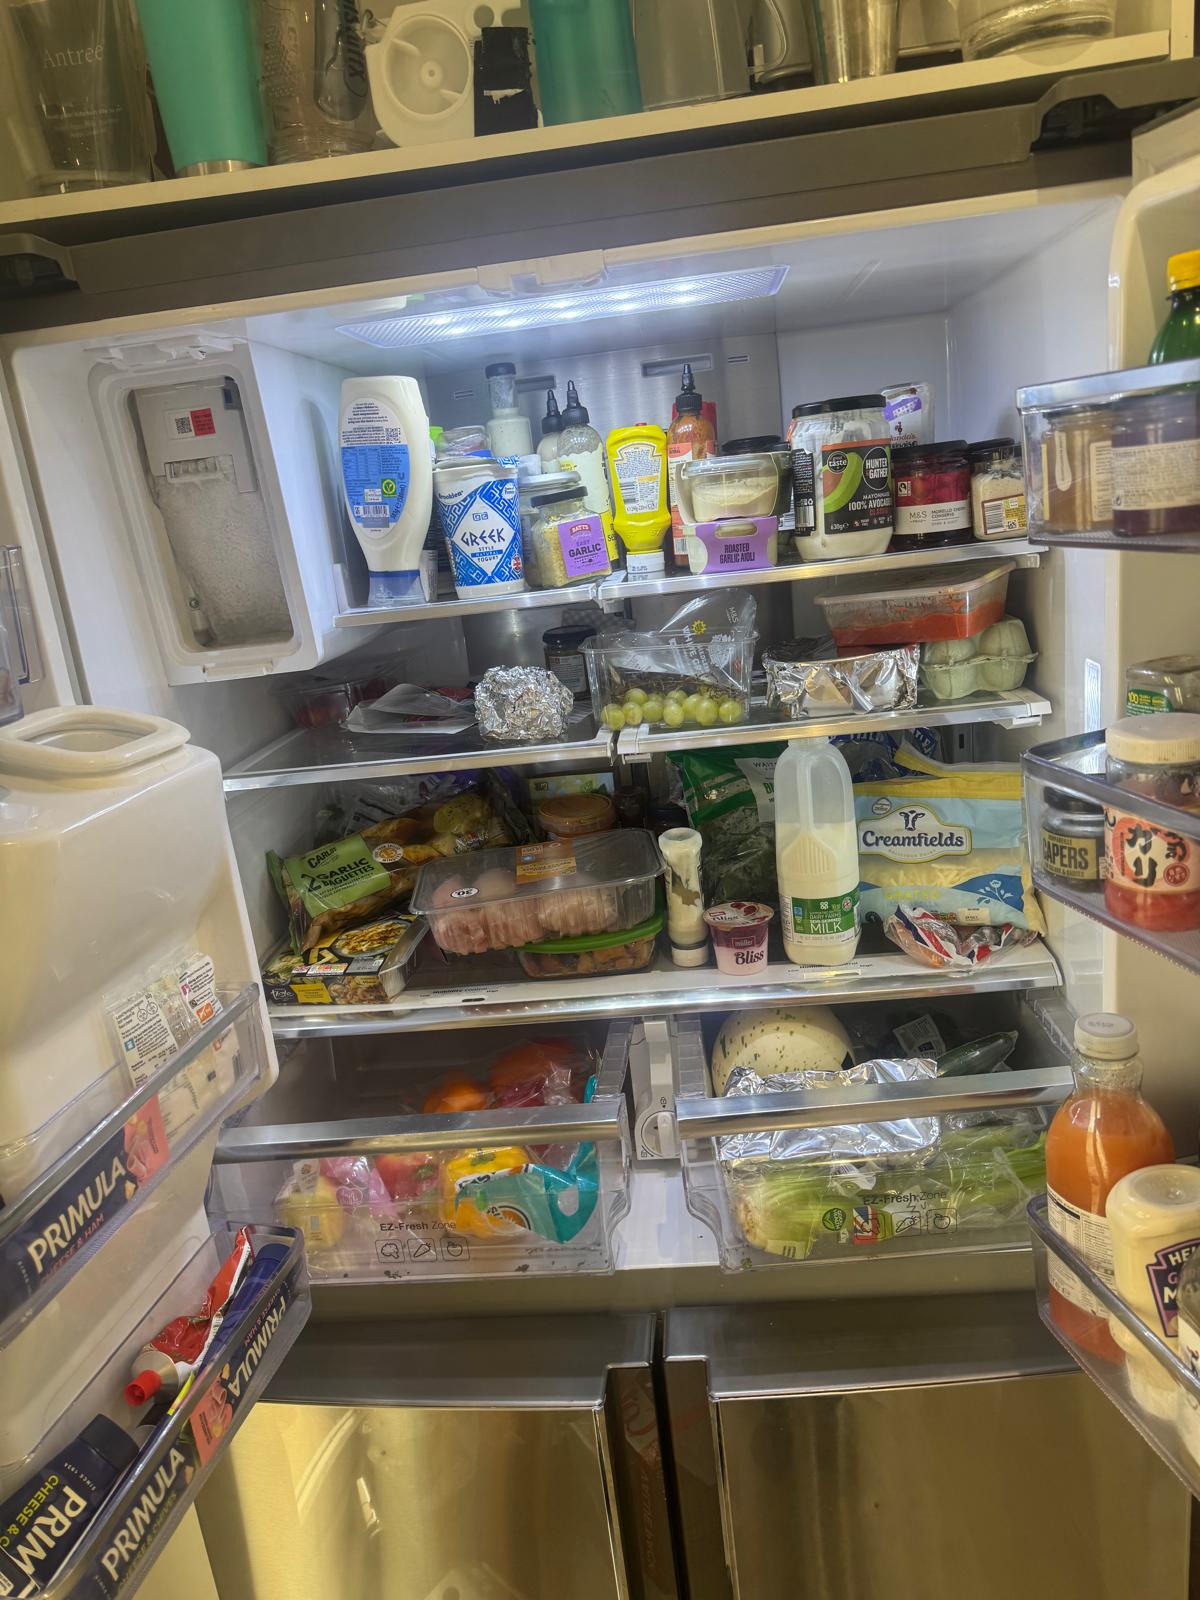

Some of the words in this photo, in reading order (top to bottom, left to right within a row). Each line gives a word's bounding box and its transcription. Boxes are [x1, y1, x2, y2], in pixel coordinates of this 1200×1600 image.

[43, 44, 104, 69] Antree
[865, 458, 887, 469] HUNTER
[848, 501, 867, 511] 100%
[909, 511, 927, 519] M&S
[461, 527, 505, 546] GREEK
[568, 543, 601, 558] GARLIC
[724, 543, 749, 553] ROASTED
[719, 553, 740, 564] GARLIC
[740, 552, 756, 562] AIOLI
[862, 830, 964, 847] Creamfields
[301, 873, 322, 892] 2
[318, 857, 369, 880] GARLIC
[322, 864, 374, 887] BAGUETTES
[810, 922, 843, 934] MILK
[734, 951, 764, 965] Bliss
[863, 1192, 917, 1206] EZ-Fresh
[919, 1190, 947, 1201] Zone
[27, 1156, 126, 1274] PRIMULA
[84, 1213, 105, 1239] HAM
[380, 1221, 429, 1232] EZ-Fresh
[431, 1220, 457, 1231] Zone
[228, 1296, 286, 1397] PRIMULA
[16, 1475, 59, 1526] CHEESE
[101, 1447, 185, 1582] PRIMULA
[7, 1523, 20, 1535] &
